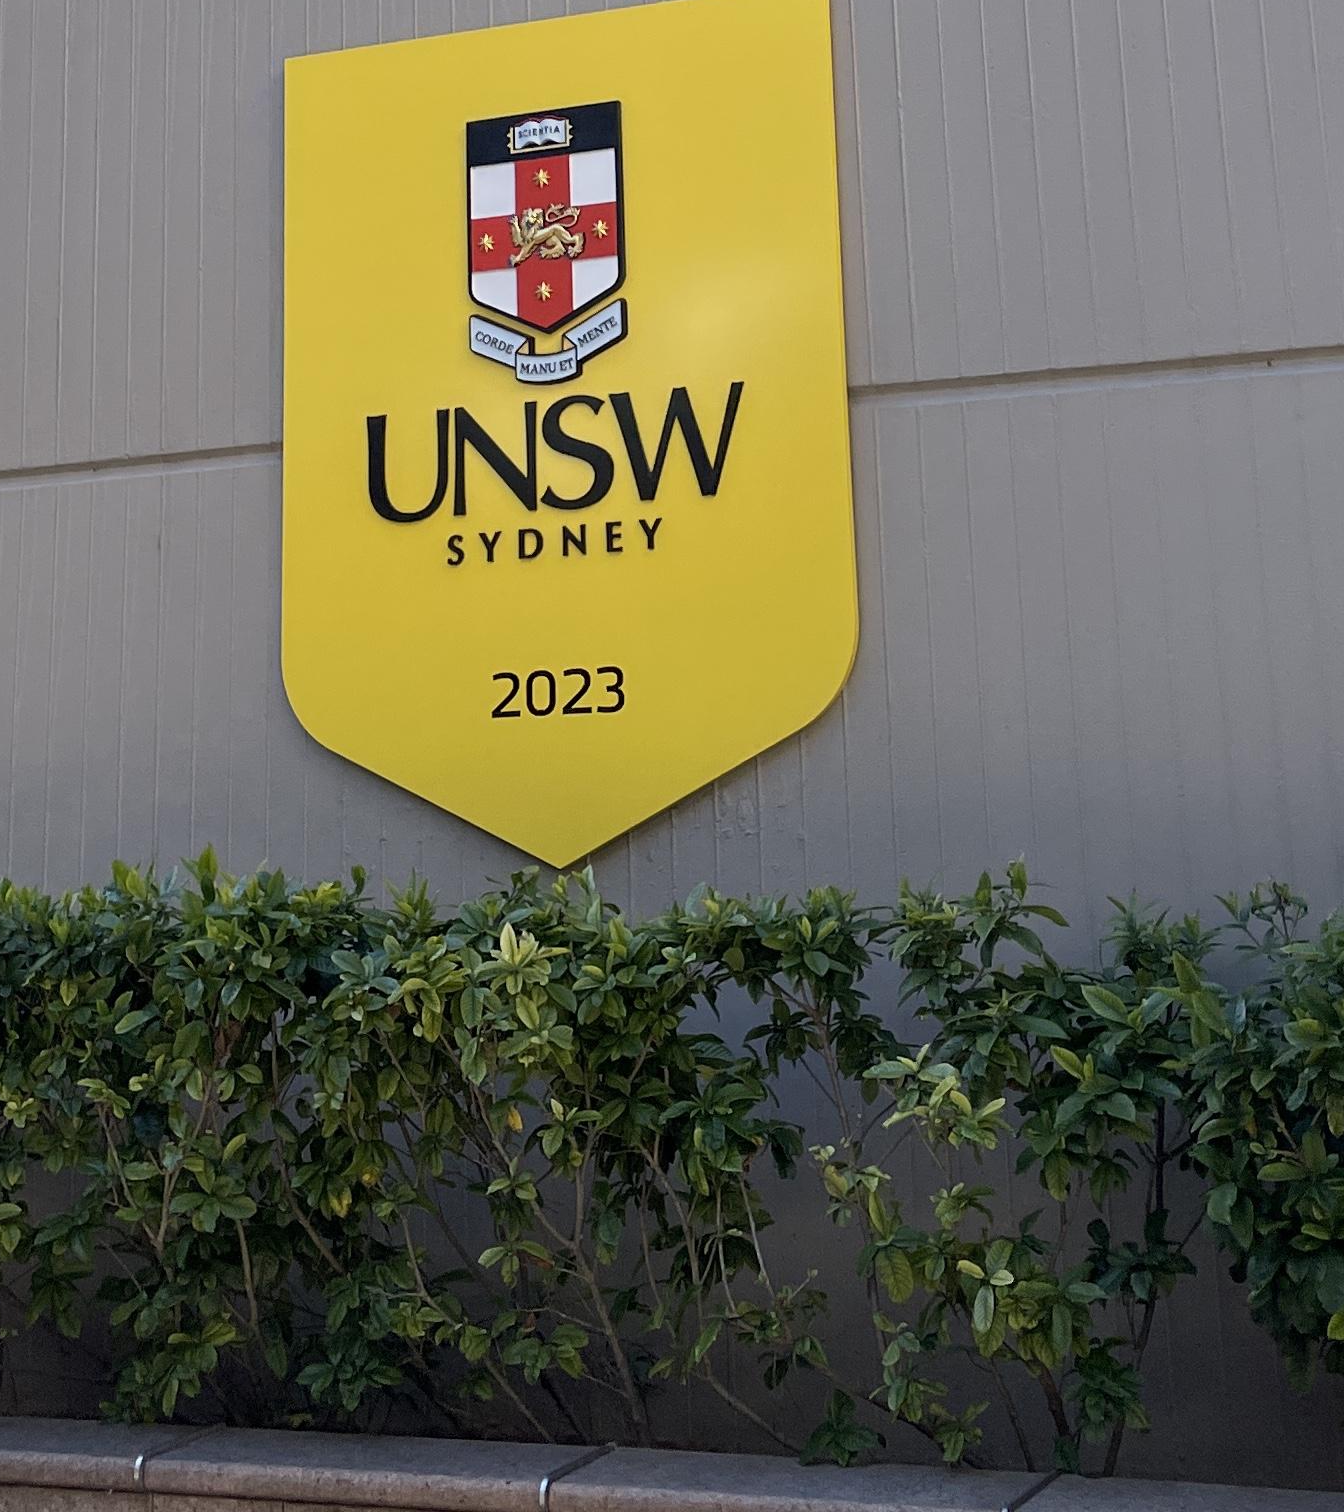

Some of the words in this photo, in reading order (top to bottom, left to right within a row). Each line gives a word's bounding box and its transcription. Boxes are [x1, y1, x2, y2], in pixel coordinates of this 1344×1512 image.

[518, 125, 561, 139] SCIENTIA
[475, 330, 515, 355] CORDE
[520, 362, 557, 375] MANU
[559, 358, 574, 372] ET
[577, 316, 618, 348] MENTE
[366, 381, 744, 523] UNSW
[447, 518, 663, 566] SYDNEY
[491, 666, 626, 719] 2023
